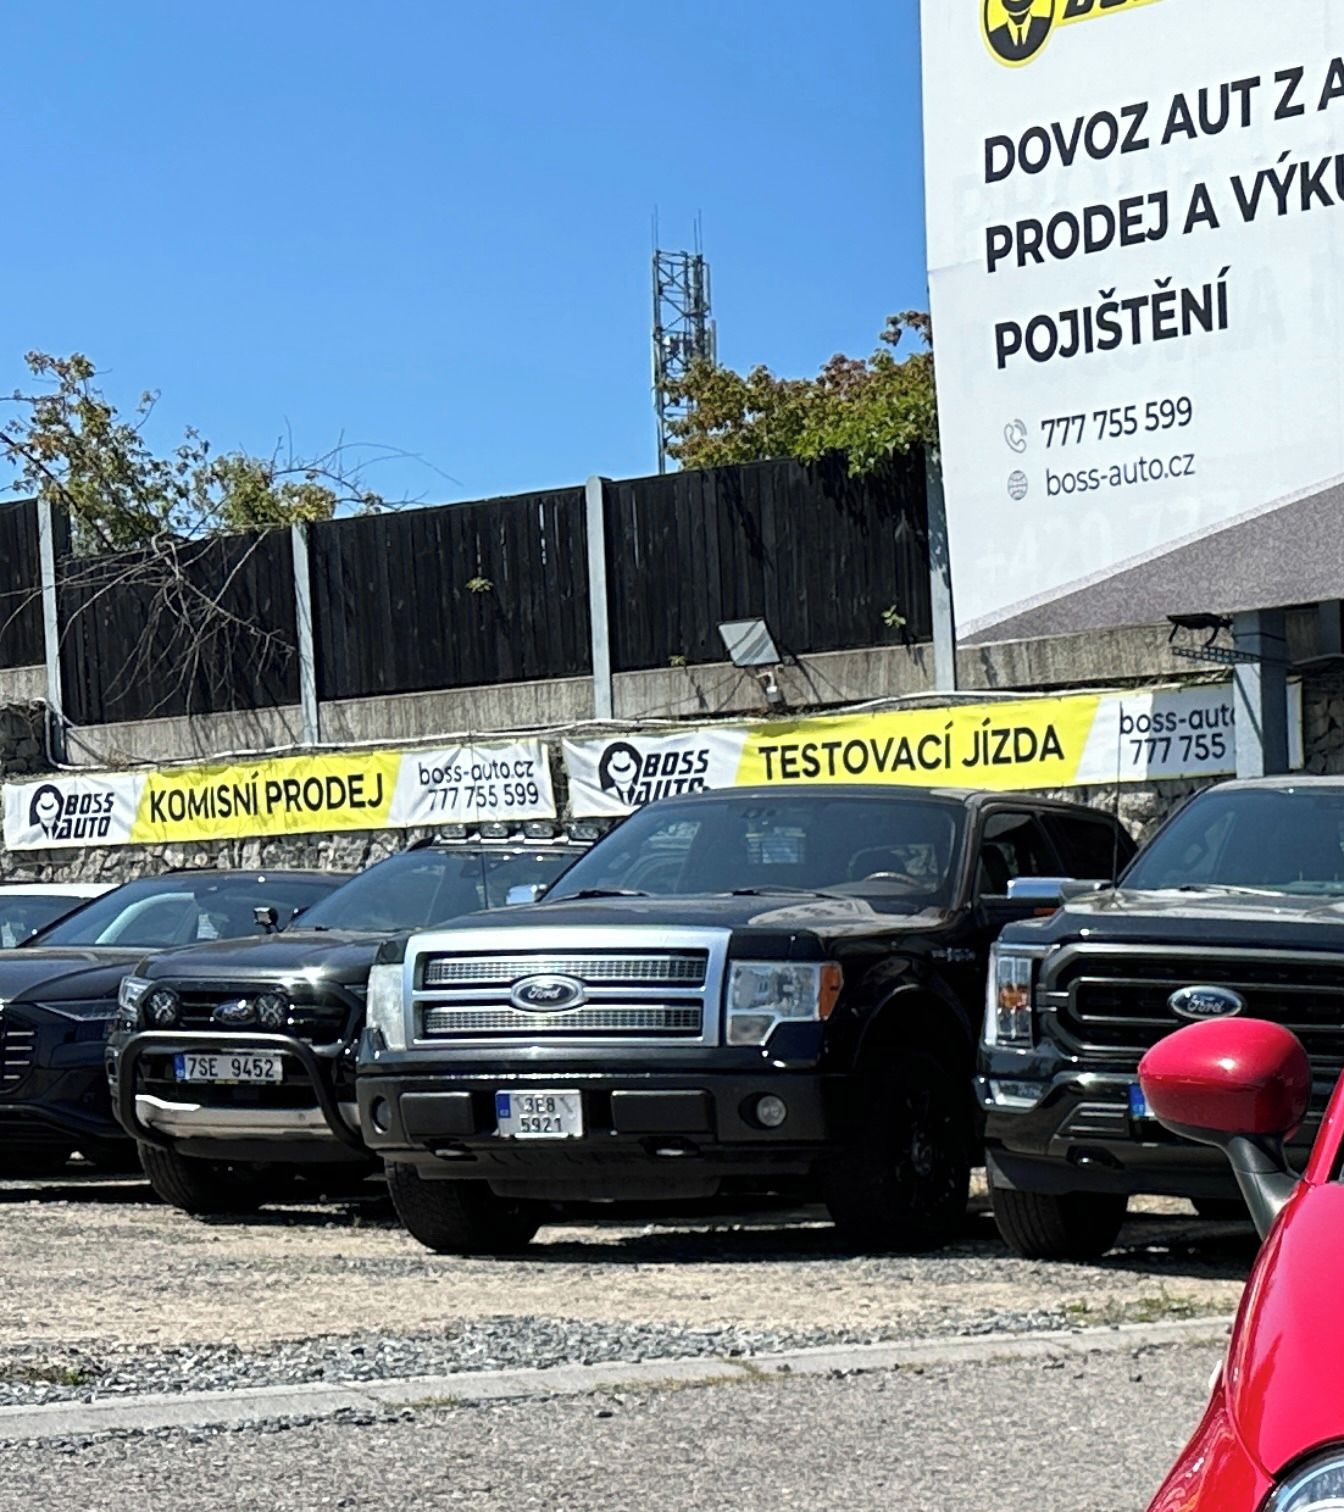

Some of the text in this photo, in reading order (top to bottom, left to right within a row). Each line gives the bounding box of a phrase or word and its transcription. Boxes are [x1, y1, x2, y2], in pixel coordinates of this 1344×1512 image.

[984, 101, 1150, 184] DOVOZ
[1160, 75, 1261, 146] AUT
[1274, 65, 1305, 121] Z
[985, 189, 1169, 273] PRODEJ
[1182, 182, 1220, 235] A
[994, 265, 1232, 370] POJIŠTĚNÍ
[1041, 396, 1193, 449] 777 755 599
[1046, 453, 1196, 496] boss-auto.cz
[642, 749, 710, 777] BOSS
[758, 716, 1065, 781] TESTOVACÍ JÍZDA
[1130, 732, 1226, 765] 777 755
[418, 760, 534, 785] boss-auto.cz
[65, 791, 115, 816] BOSS
[150, 770, 384, 823] KOMISNÍ PRODEJ
[428, 781, 539, 811] 777 755 599
[55, 815, 111, 840] AUTO
[527, 985, 562, 1000] Ford
[1187, 994, 1225, 1013] Ford
[187, 1057, 274, 1079] 7SE 9452
[520, 1116, 563, 1133] 5921
